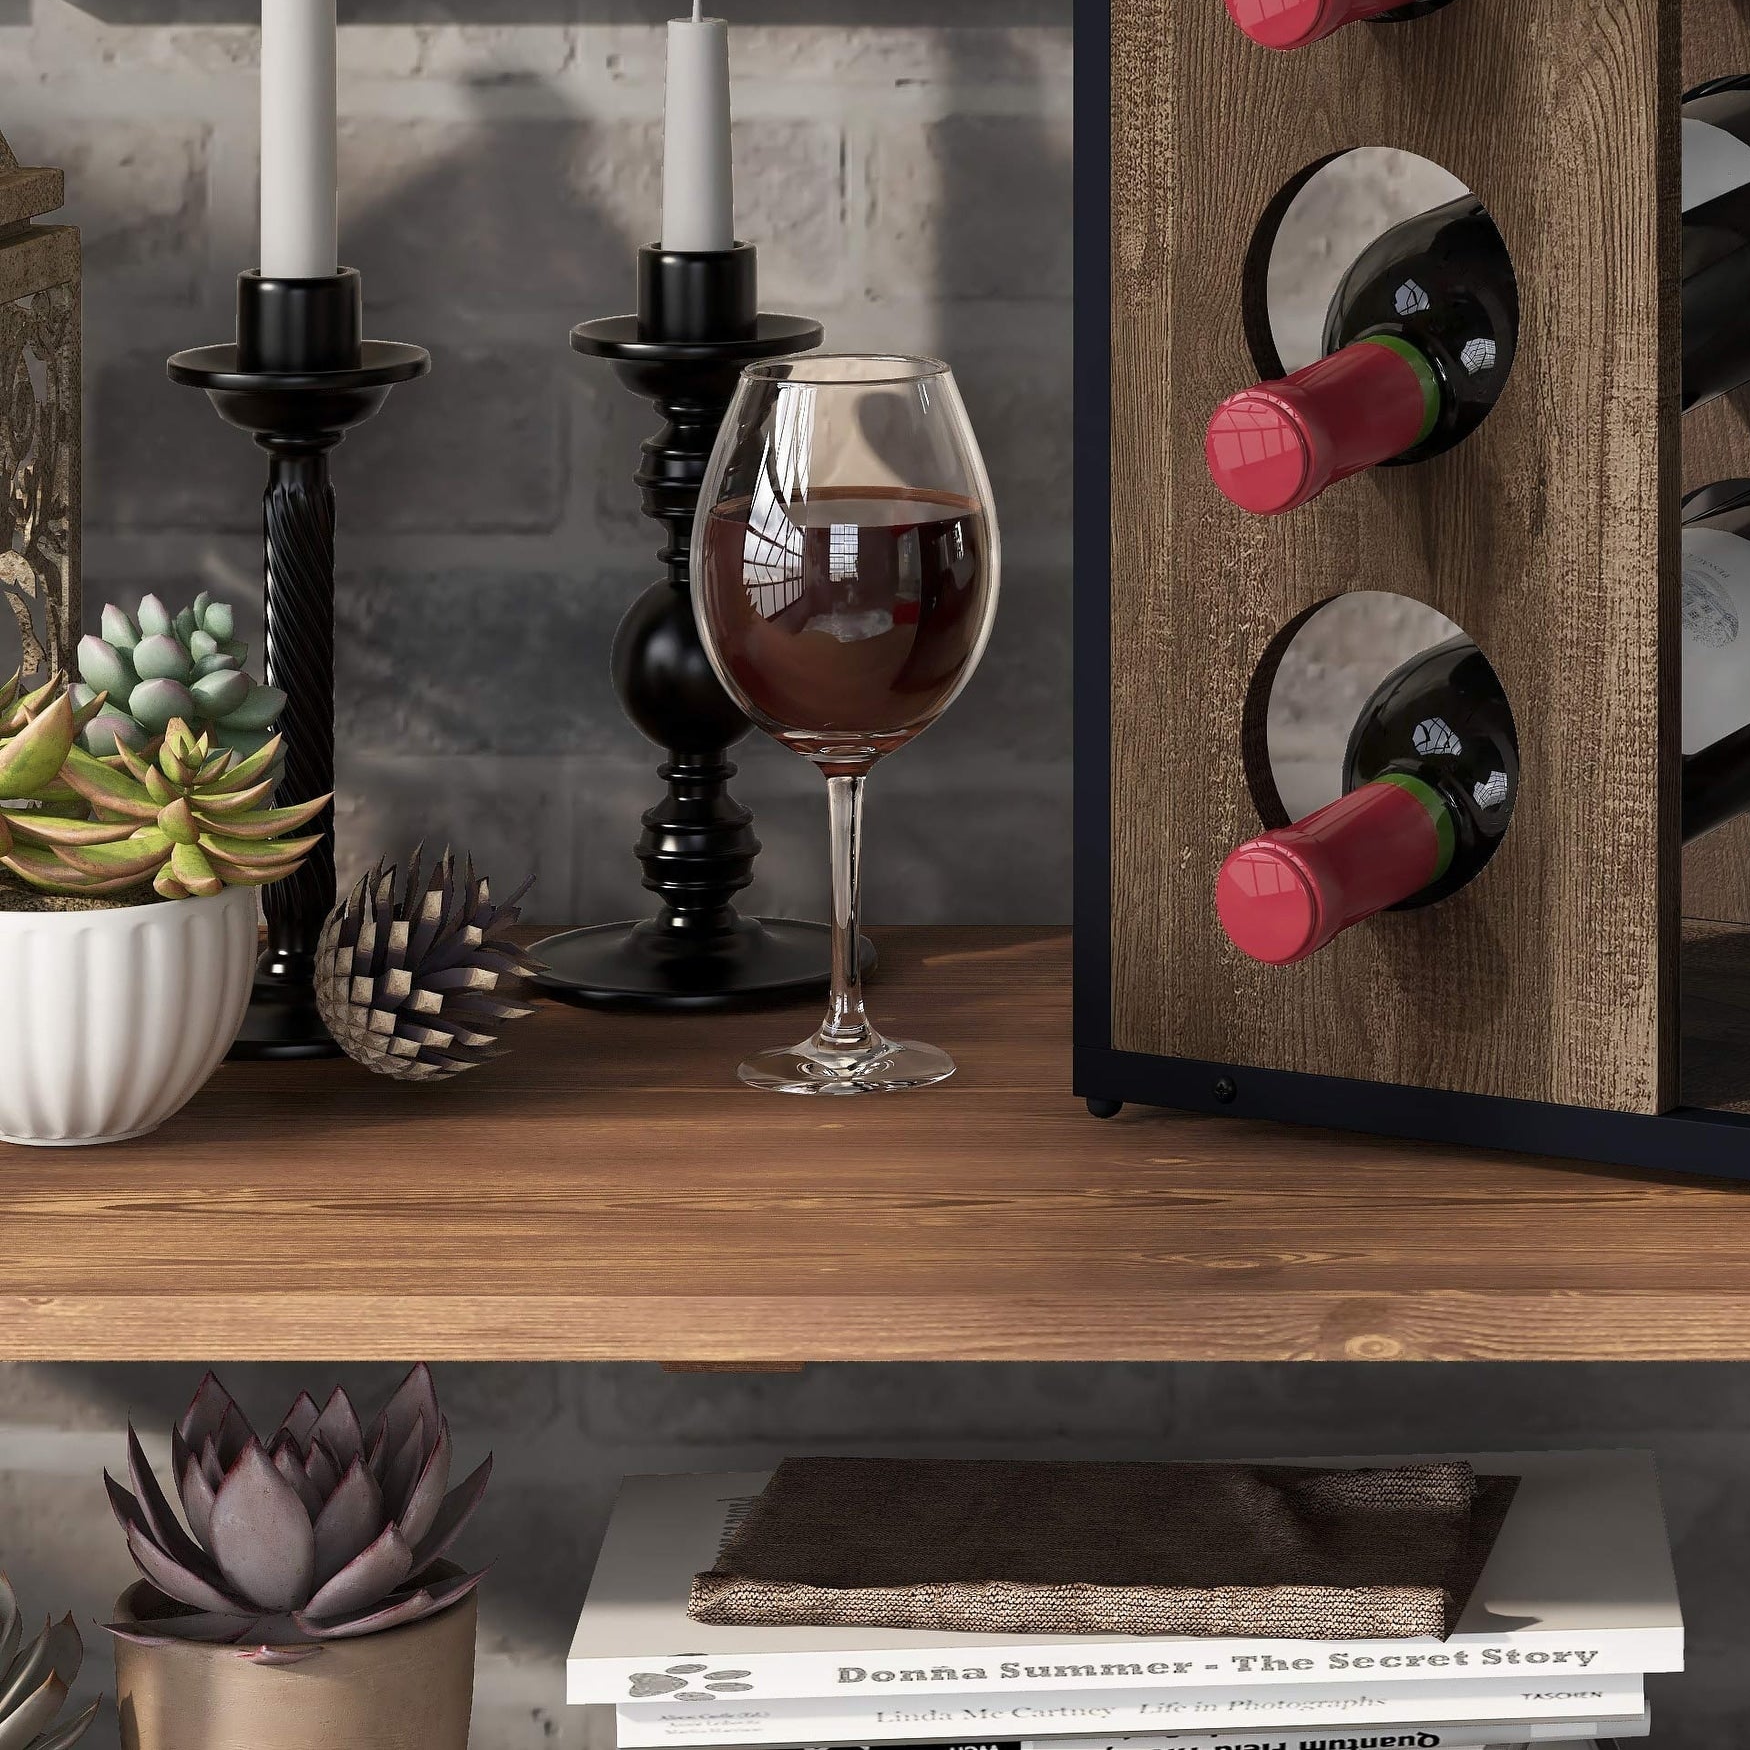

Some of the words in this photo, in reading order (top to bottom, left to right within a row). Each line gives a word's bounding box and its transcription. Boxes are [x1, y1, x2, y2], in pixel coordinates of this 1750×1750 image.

[1000, 1659, 1193, 1680] Summer
[1231, 1654, 1315, 1672] The
[1328, 1650, 1470, 1670] Secret
[1481, 1648, 1600, 1668] Story
[1521, 1691, 1604, 1701] TASCHEN
[876, 1711, 953, 1724] Linda
[1011, 1705, 1116, 1720] Cartney
[1139, 1700, 1188, 1715] Life
[1228, 1694, 1387, 1712] Photographs
[1299, 1731, 1441, 1750] Quantum
